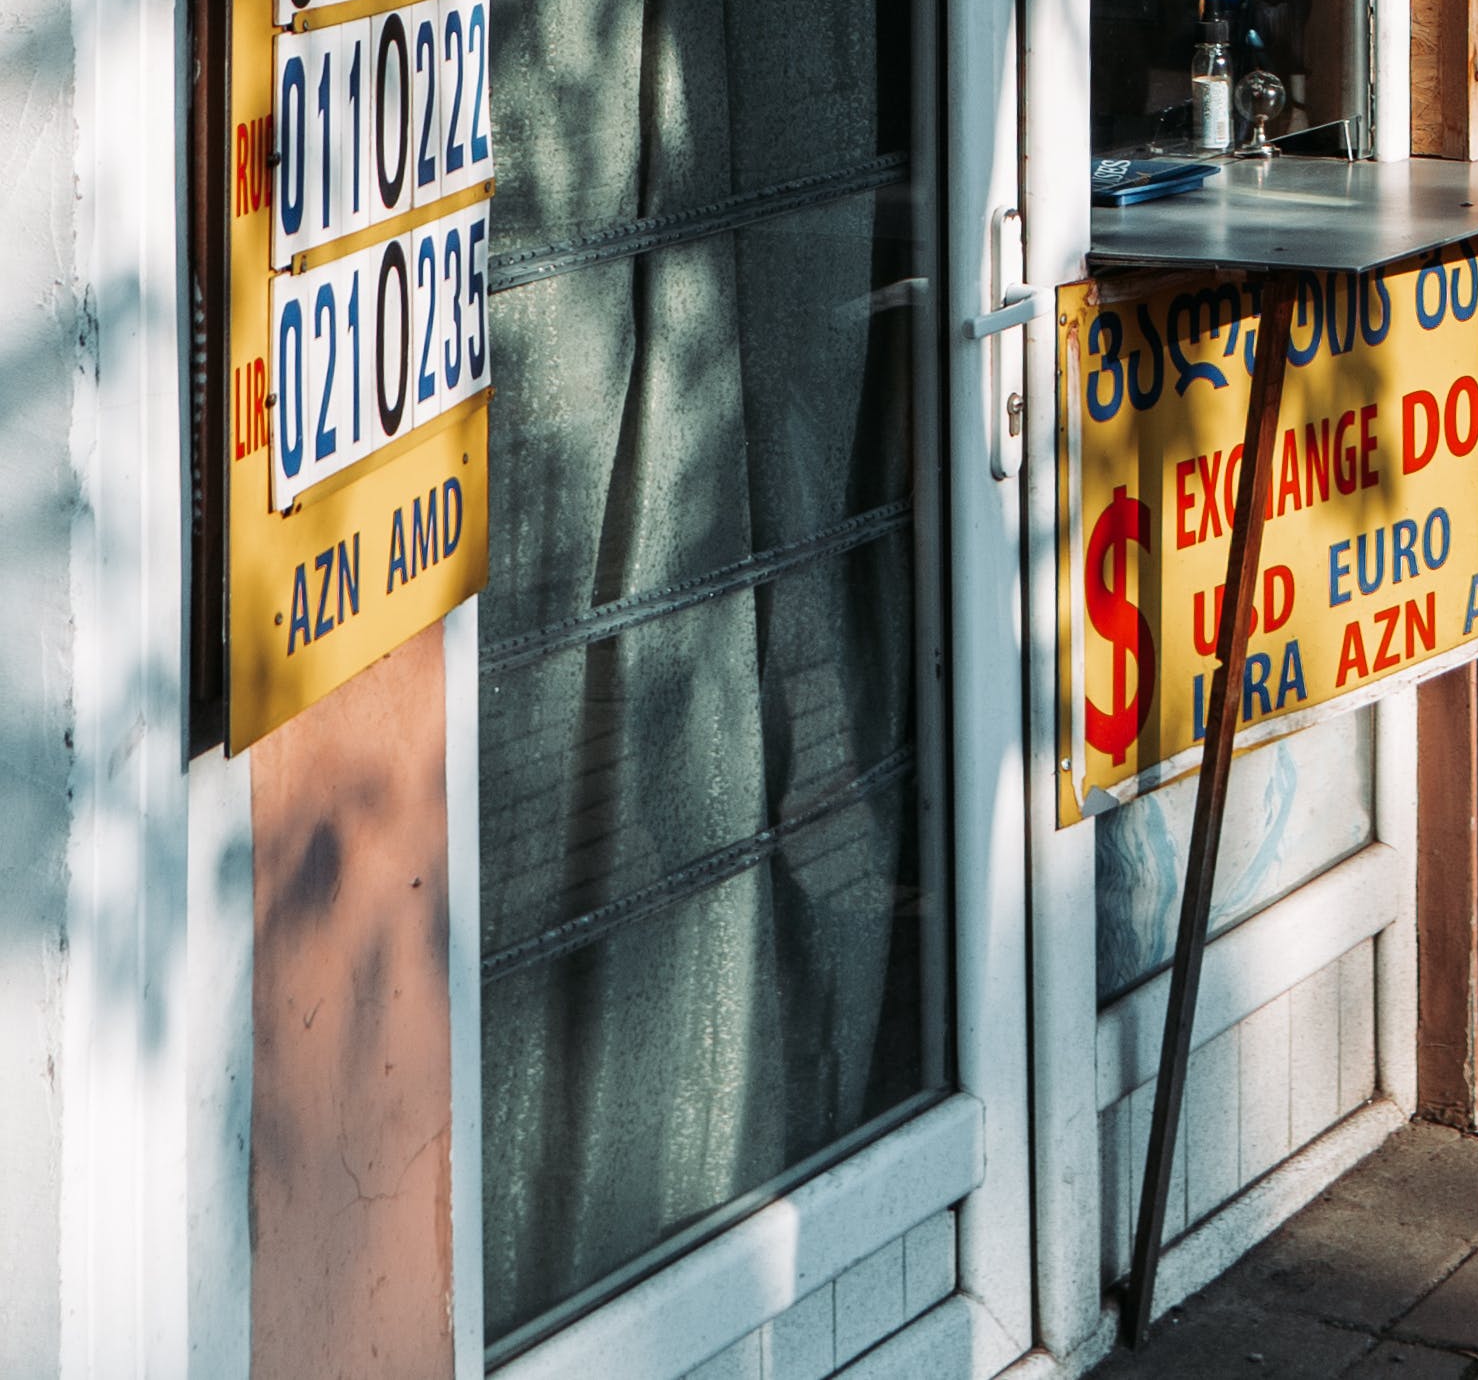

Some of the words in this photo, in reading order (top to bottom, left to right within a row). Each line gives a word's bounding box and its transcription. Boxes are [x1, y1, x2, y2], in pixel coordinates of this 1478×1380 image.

[1176, 403, 1379, 551] EXCANGE
[288, 532, 360, 658] AZN
[386, 477, 463, 595] AMD
[1329, 506, 1451, 609] EURO
[1193, 639, 1308, 742] LRA
[1336, 592, 1436, 689] AZN
